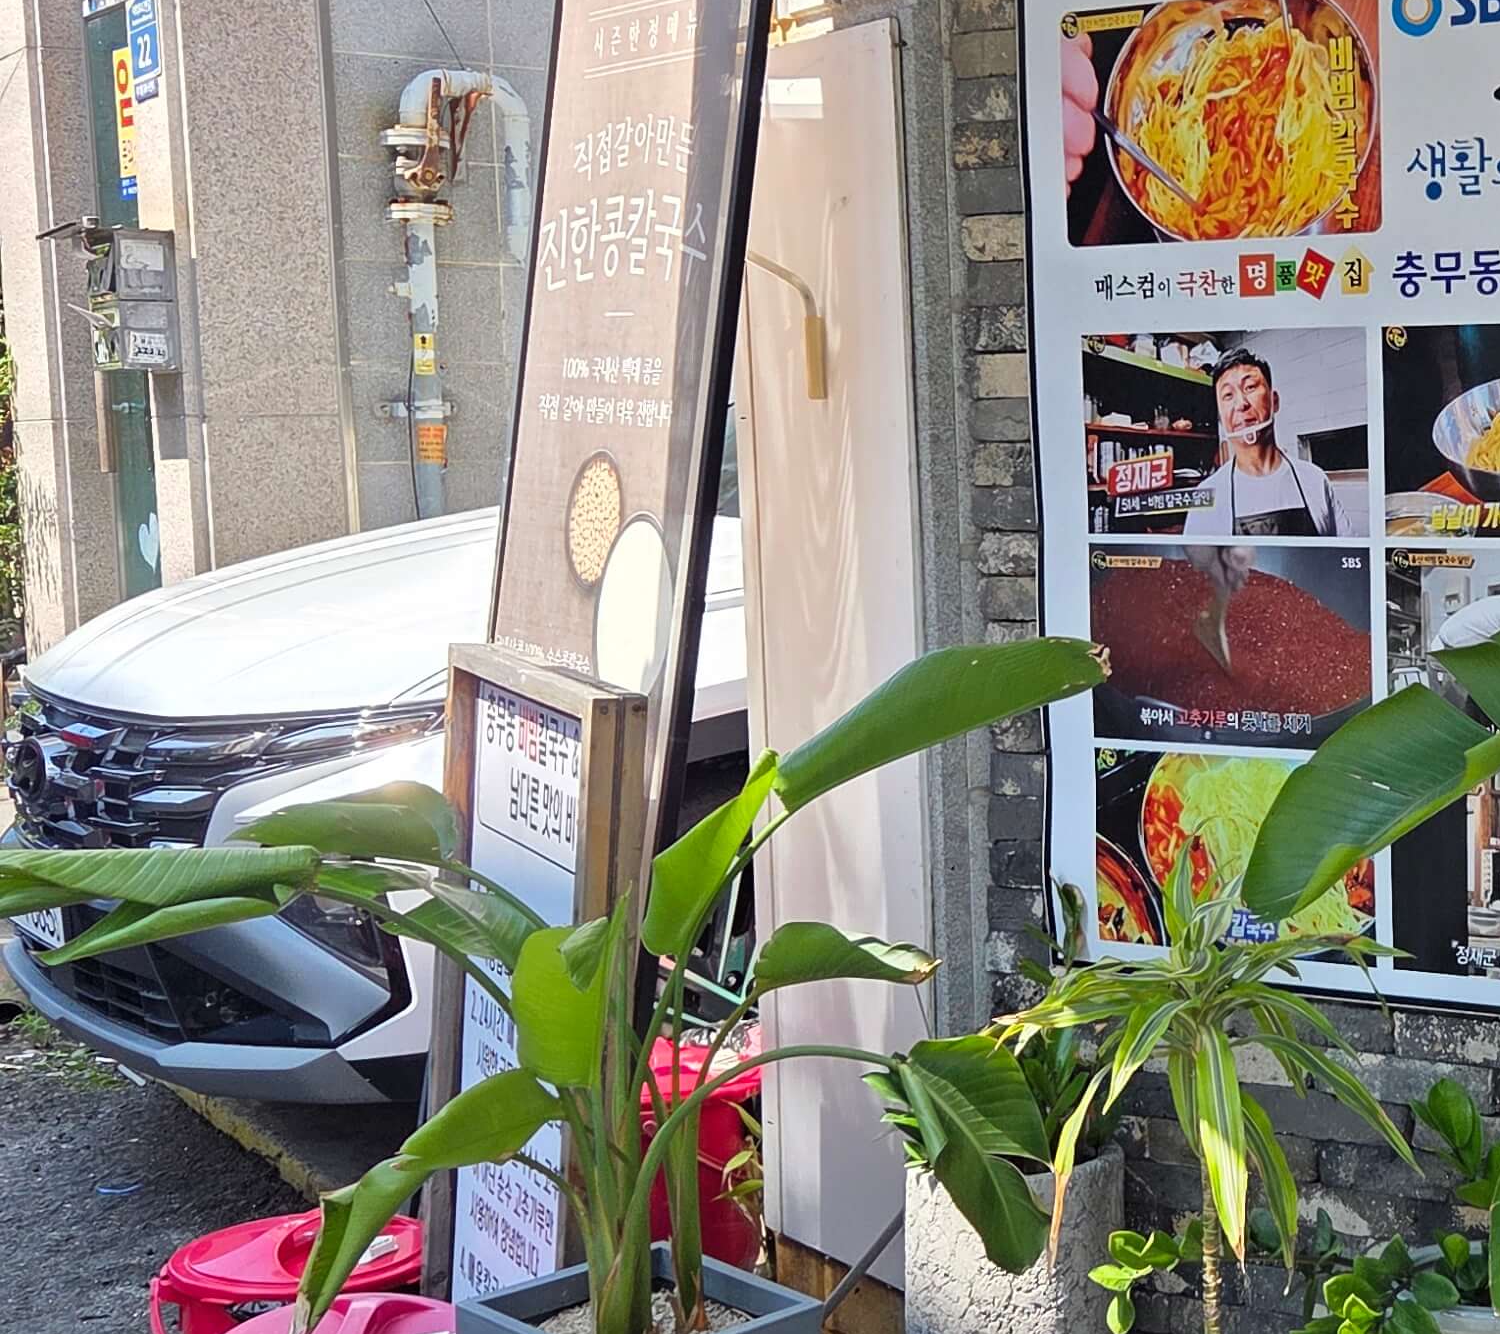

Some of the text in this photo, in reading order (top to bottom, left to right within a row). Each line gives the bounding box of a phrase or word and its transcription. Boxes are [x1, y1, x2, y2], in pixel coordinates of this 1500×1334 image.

[136, 33, 152, 69] 22
[1328, 35, 1357, 111] 비빔
[1095, 272, 1171, 301] 매스컴이
[1176, 269, 1235, 297] 극찬한
[1115, 459, 1167, 493] 정재군
[1341, 556, 1362, 569] SBS
[487, 690, 517, 753] 충무동
[1139, 706, 1174, 726] 볶아서
[509, 766, 576, 852] 남다른 맛의 비
